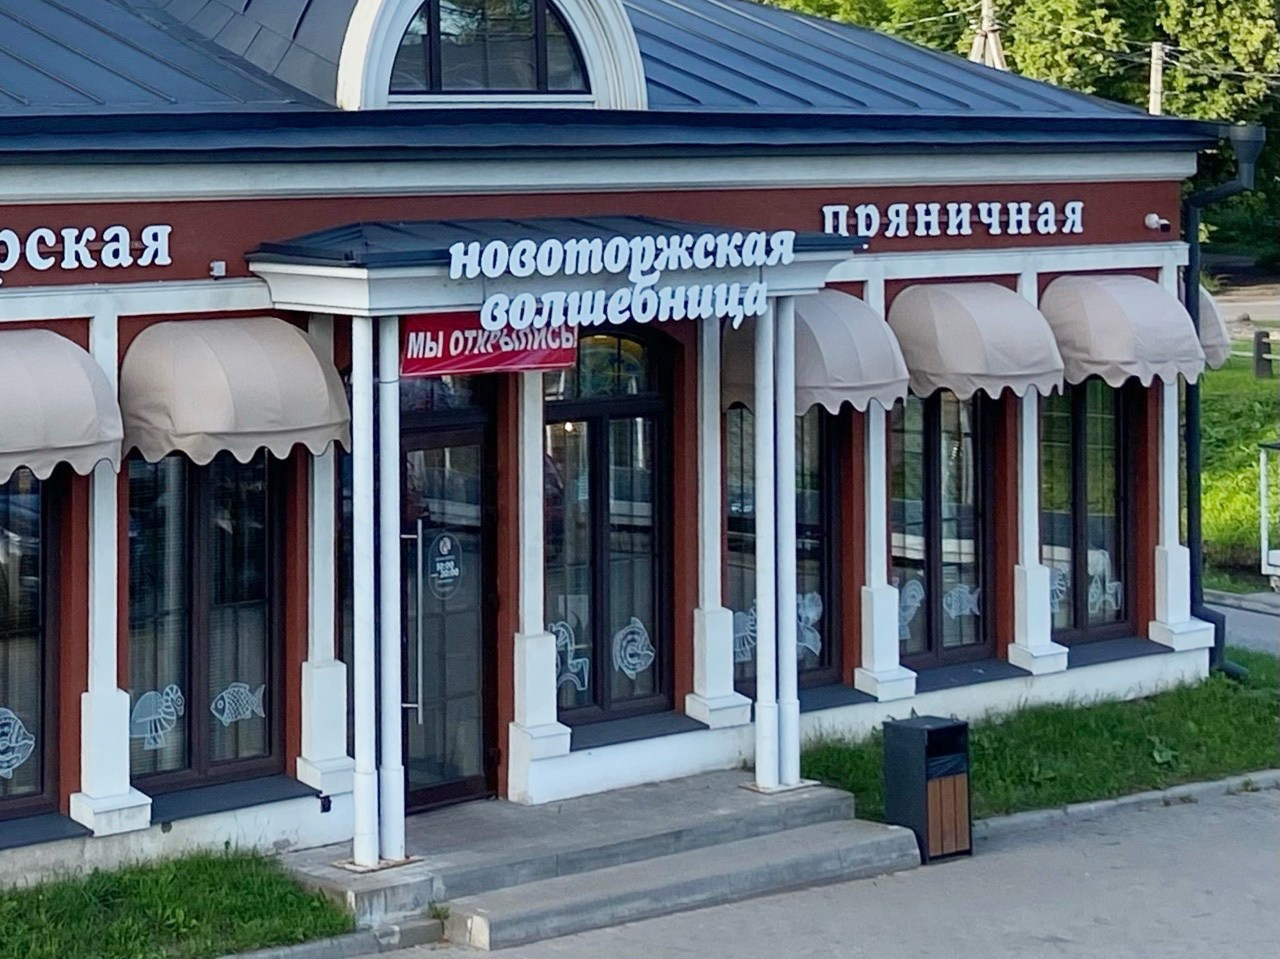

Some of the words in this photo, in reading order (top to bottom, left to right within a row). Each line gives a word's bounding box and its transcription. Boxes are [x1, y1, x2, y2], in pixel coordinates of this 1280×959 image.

[822, 200, 1085, 249] пряничная
[448, 230, 796, 284] новоторжская
[480, 271, 769, 331] волшебница
[407, 331, 444, 359] МЫ
